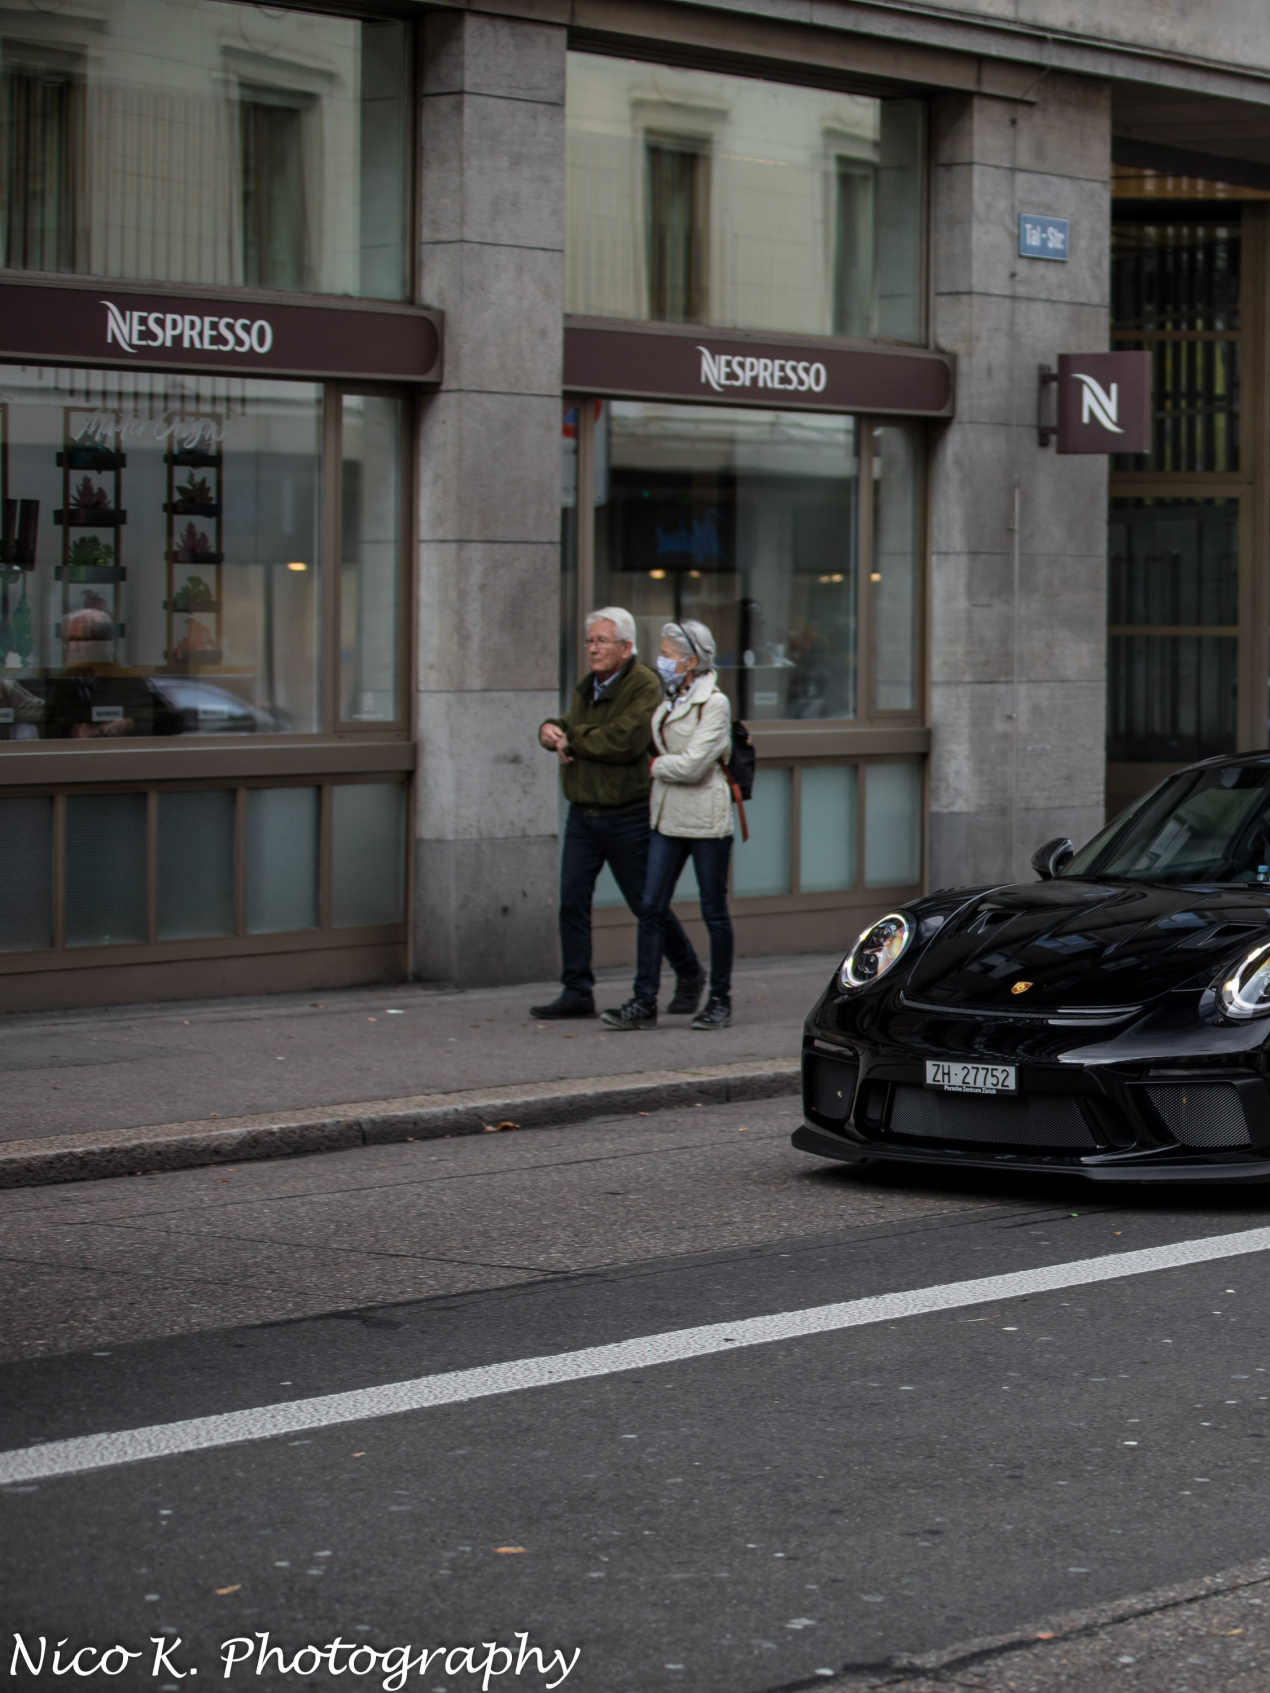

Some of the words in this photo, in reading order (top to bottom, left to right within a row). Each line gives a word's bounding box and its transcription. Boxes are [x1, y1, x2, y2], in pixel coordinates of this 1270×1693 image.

[100, 301, 273, 353] NESPRESSO
[695, 345, 827, 393] NESPRESSO
[1071, 373, 1126, 434] N
